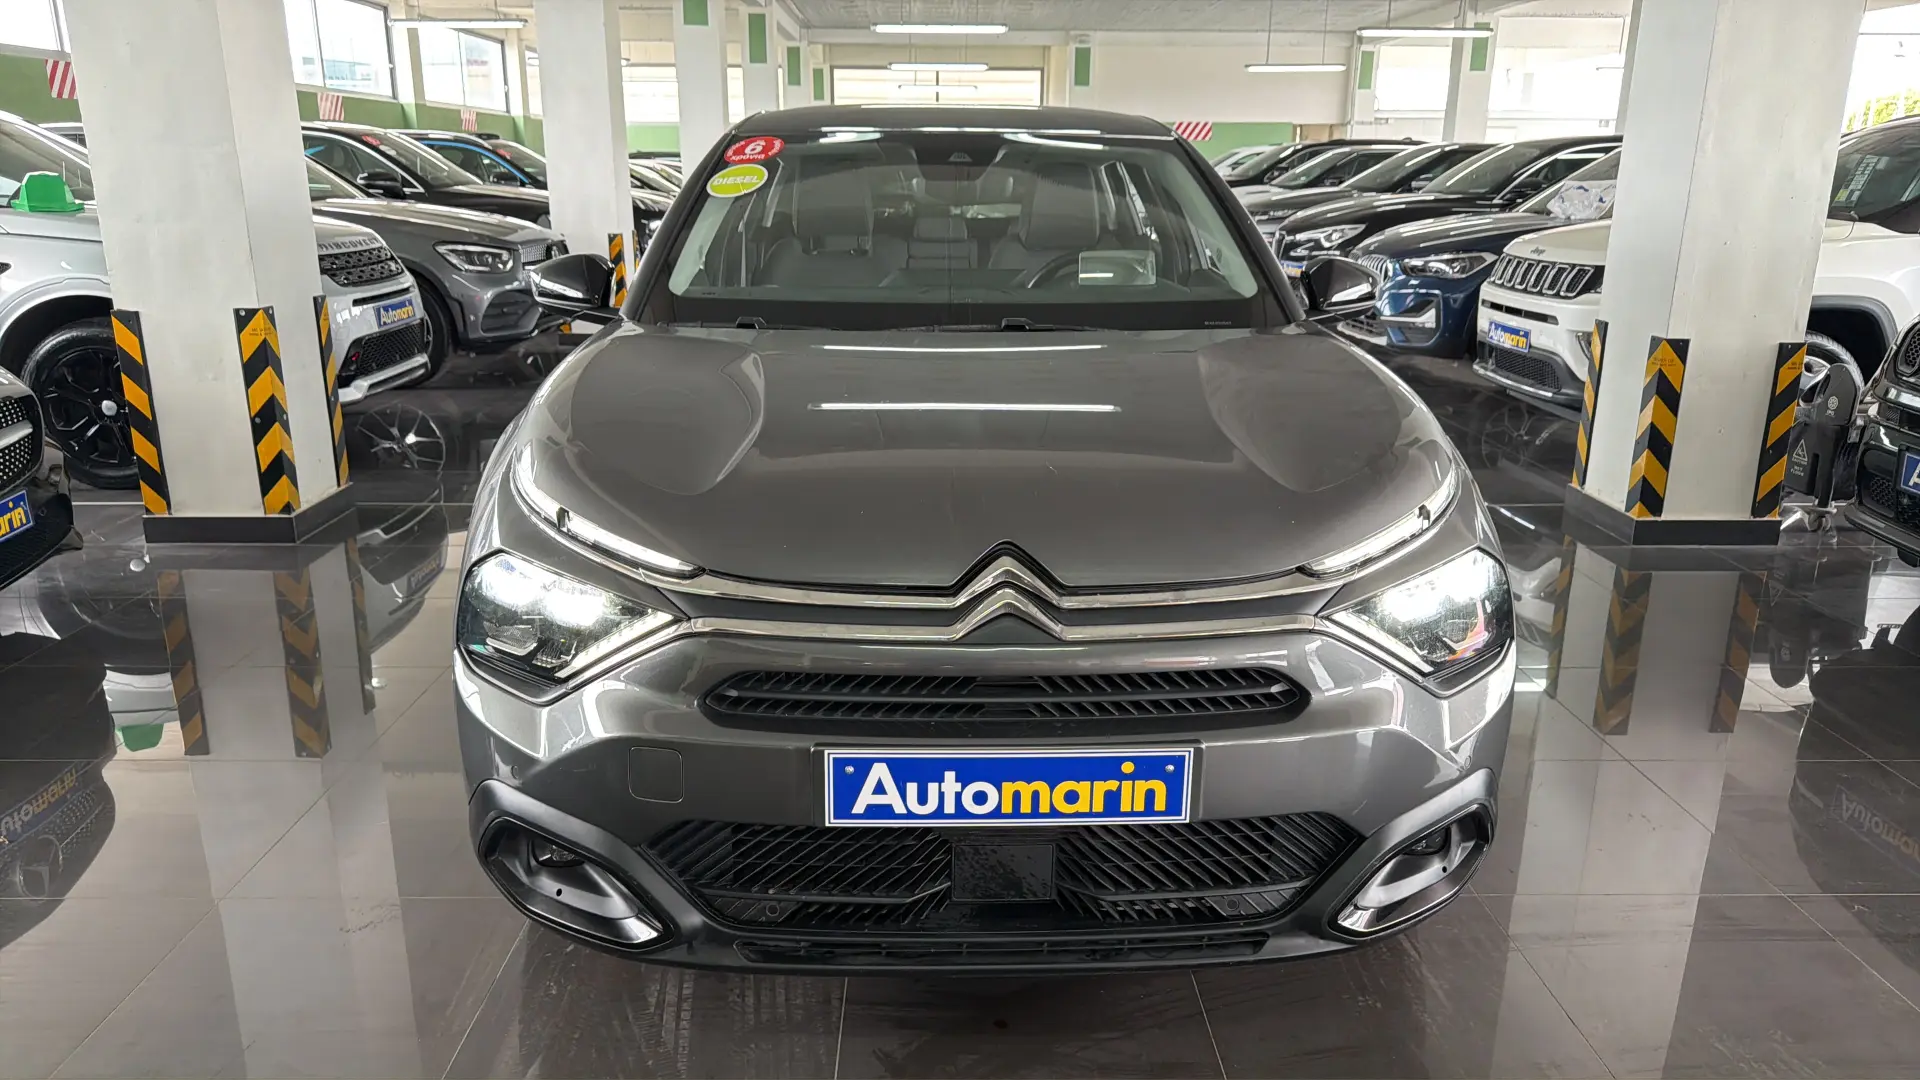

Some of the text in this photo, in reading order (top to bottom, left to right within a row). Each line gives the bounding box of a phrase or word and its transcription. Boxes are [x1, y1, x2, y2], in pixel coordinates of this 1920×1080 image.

[744, 140, 766, 154] 6
[712, 175, 760, 185] DIESEL
[380, 301, 414, 325] Automarin
[1488, 322, 1527, 349] Automarin
[851, 762, 1167, 815] Automarin
